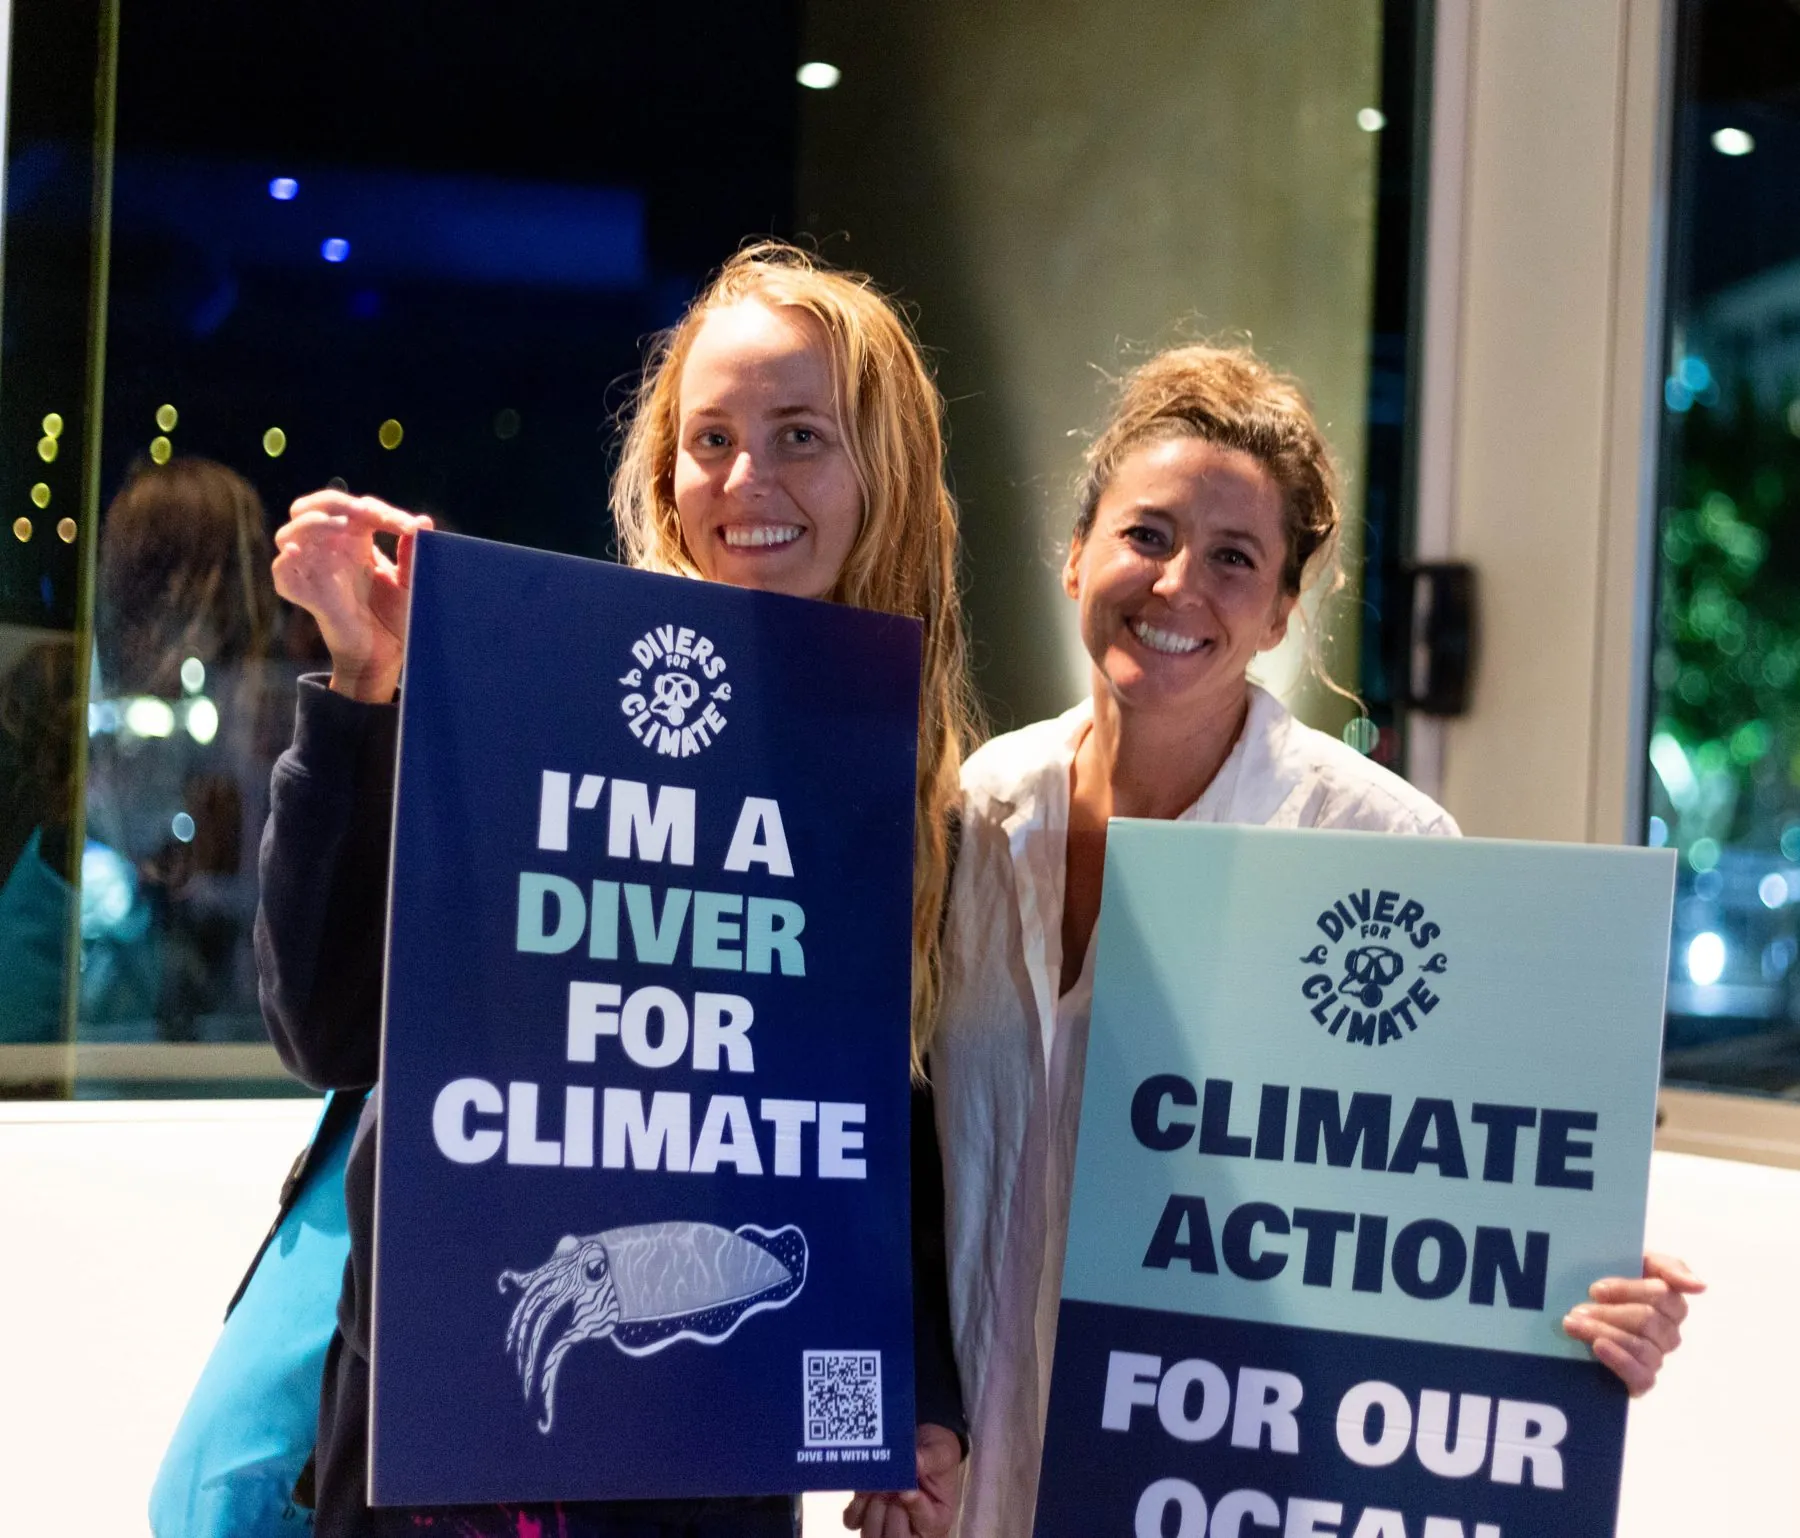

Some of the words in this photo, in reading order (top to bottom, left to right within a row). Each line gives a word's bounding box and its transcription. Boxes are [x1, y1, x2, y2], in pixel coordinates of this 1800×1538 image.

[632, 624, 726, 679] DIVERS
[666, 654, 690, 669] FOR
[622, 693, 727, 758] CLIMATE
[538, 770, 696, 866] I'M
[723, 796, 794, 877] A
[516, 871, 806, 977] DIVER
[1316, 888, 1441, 949] DIVERS
[1360, 923, 1391, 939] FOR
[566, 981, 755, 1073] FOR
[1302, 974, 1440, 1046] CLIMATE
[432, 1077, 867, 1179] CLIMATE
[1130, 1073, 1598, 1191] CLIMATE
[1141, 1193, 1550, 1312] ACTION
[797, 1450, 823, 1463] DIVE
[826, 1450, 838, 1462] IN
[841, 1449, 869, 1462] WITH
[872, 1448, 890, 1461] US!
[1101, 1349, 1304, 1455] FOR
[1336, 1380, 1568, 1490] OUR
